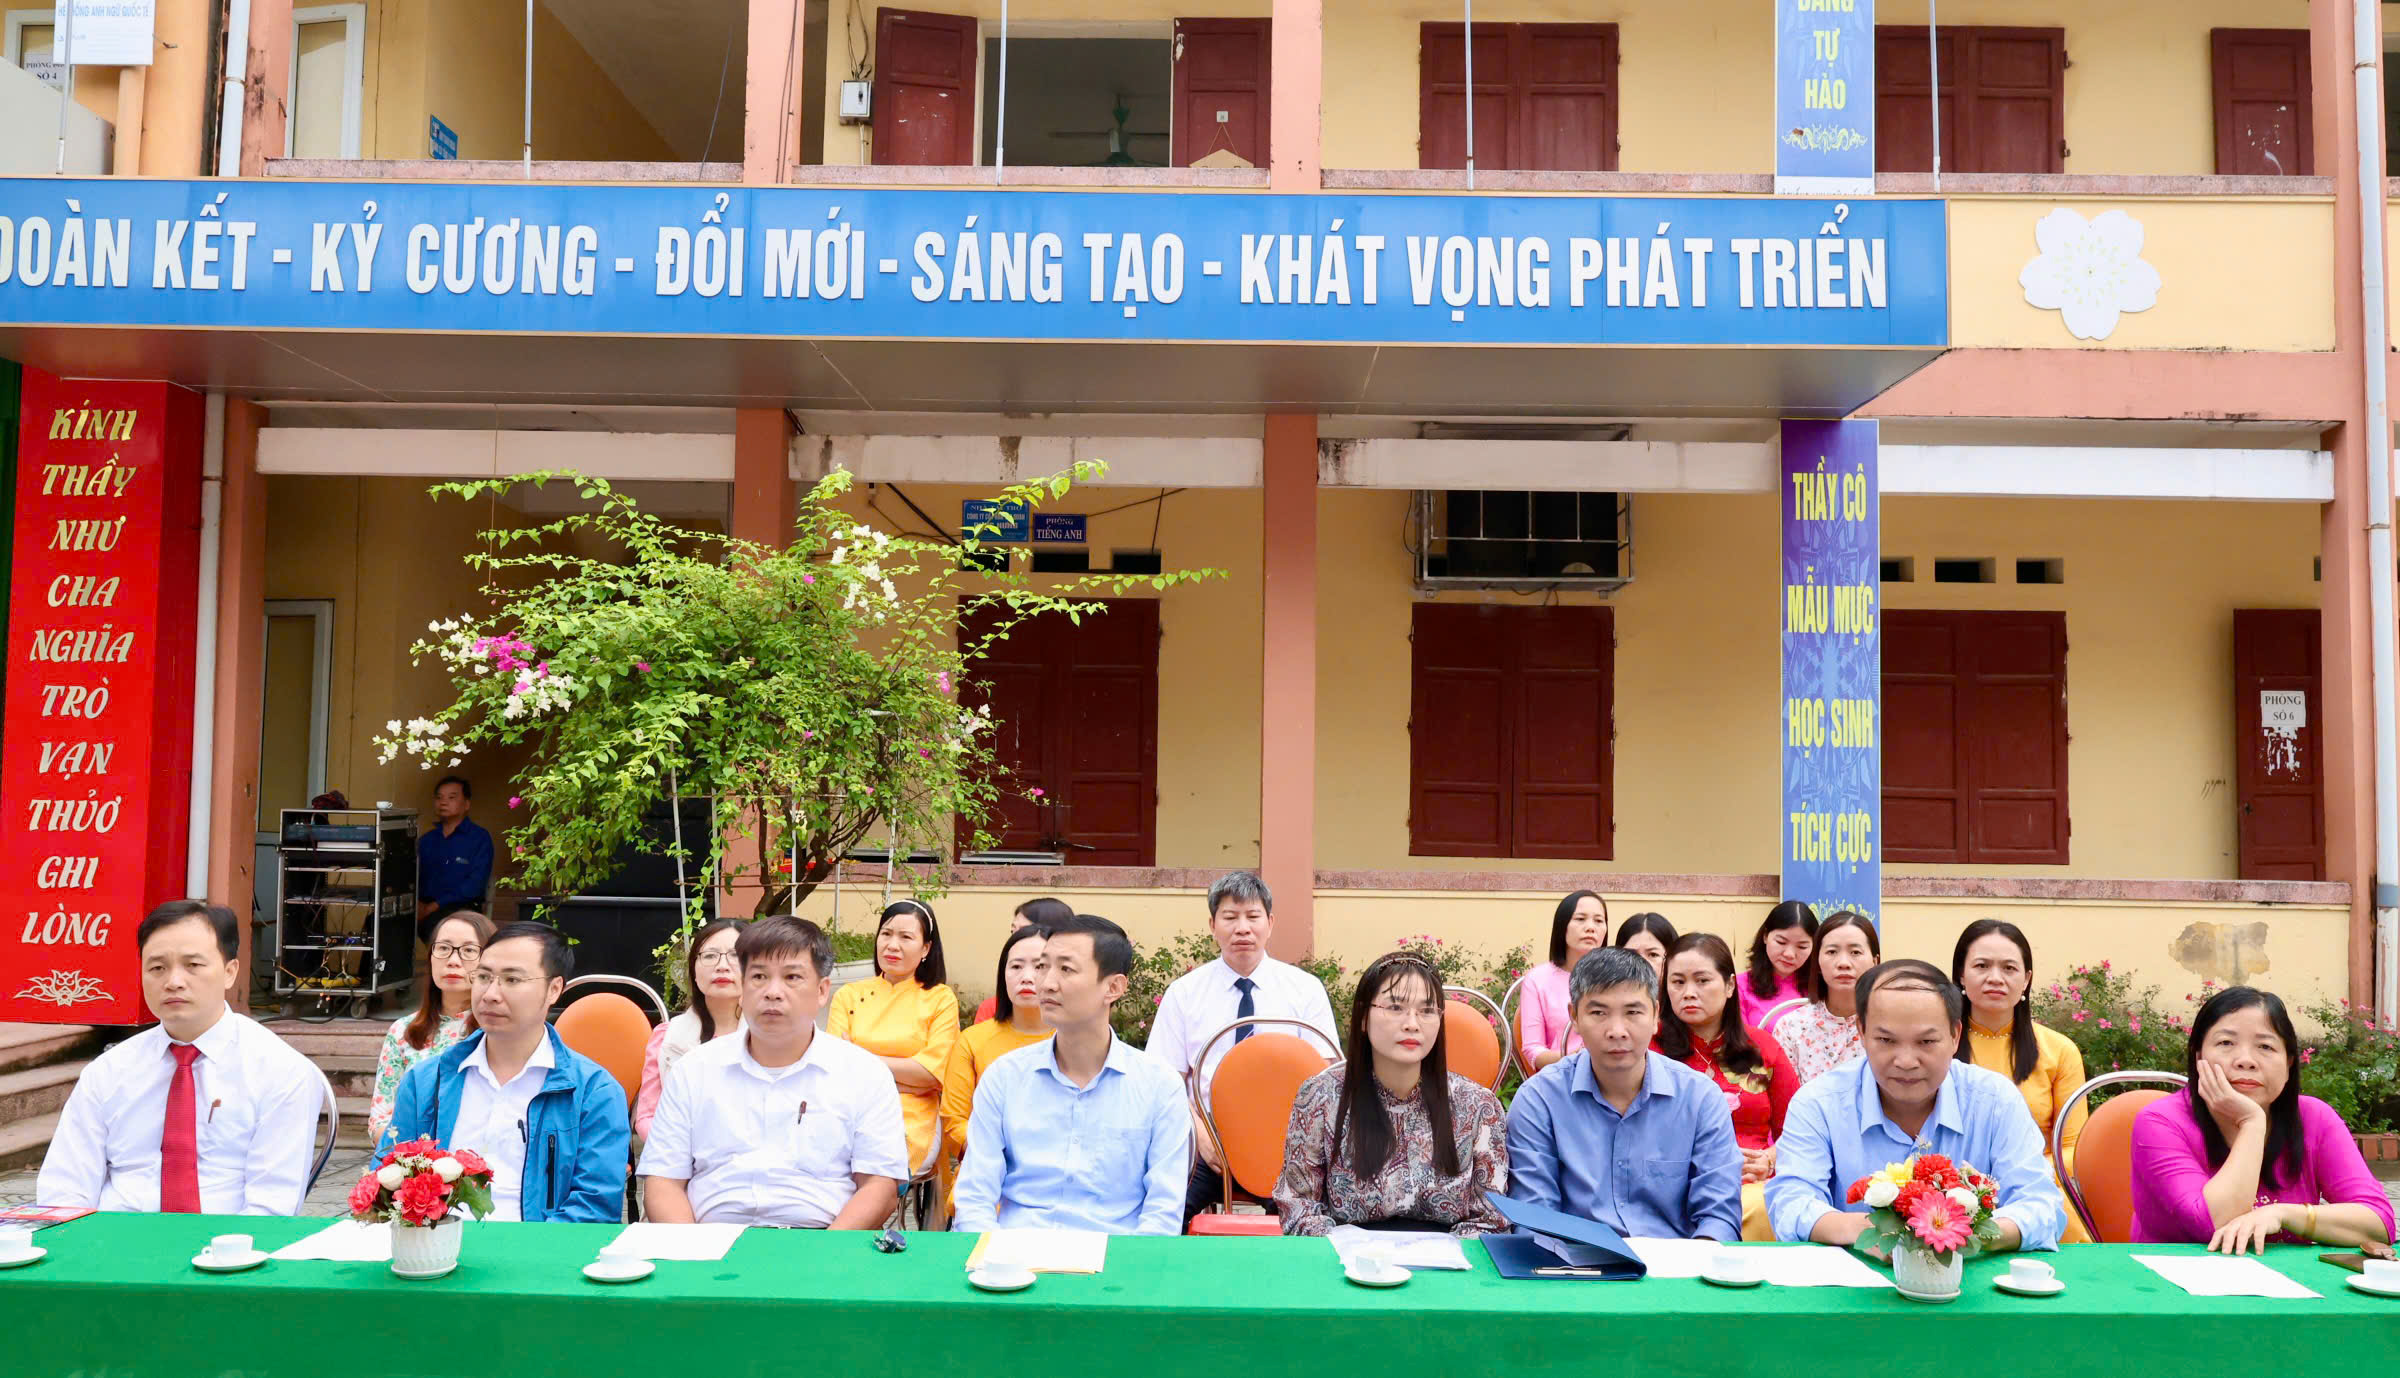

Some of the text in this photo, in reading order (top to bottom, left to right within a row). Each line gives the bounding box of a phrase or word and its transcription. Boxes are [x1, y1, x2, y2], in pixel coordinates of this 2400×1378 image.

[1813, 28, 1841, 68] TỰ
[1805, 72, 1846, 110] HÀO
[152, 192, 256, 290] KẾT
[310, 201, 383, 292] KỶ
[406, 217, 598, 296] CƯƠNG
[655, 192, 745, 297] ĐỔI
[763, 206, 865, 300] MỚI
[911, 215, 1063, 303] SÁNG
[1082, 232, 1185, 318] TẠO
[1240, 218, 1386, 304] KHÁT
[1406, 235, 1550, 321] VỌNG
[1569, 222, 1714, 307] PHÁT
[1730, 203, 1886, 308] TRIỂN
[49, 399, 137, 441] KÍNH
[42, 452, 136, 497] THẦY
[1792, 456, 1867, 521] THẦY CÔ
[48, 515, 127, 551] NHƯ
[1037, 525, 1062, 539] TIẾNG
[1064, 530, 1082, 540] ANH
[47, 574, 121, 607] CHA
[1787, 566, 1874, 645] MẪU MỰC
[29, 624, 135, 662] NGHĨA
[41, 677, 110, 719] TRÒ
[2289, 711, 2294, 720] 6
[1788, 698, 1873, 758] HỌC SINH
[38, 742, 114, 780] VẠN
[1790, 802, 1872, 874] TÍCH CỰC
[37, 856, 99, 889] GHI
[21, 903, 112, 947] LÒNG
